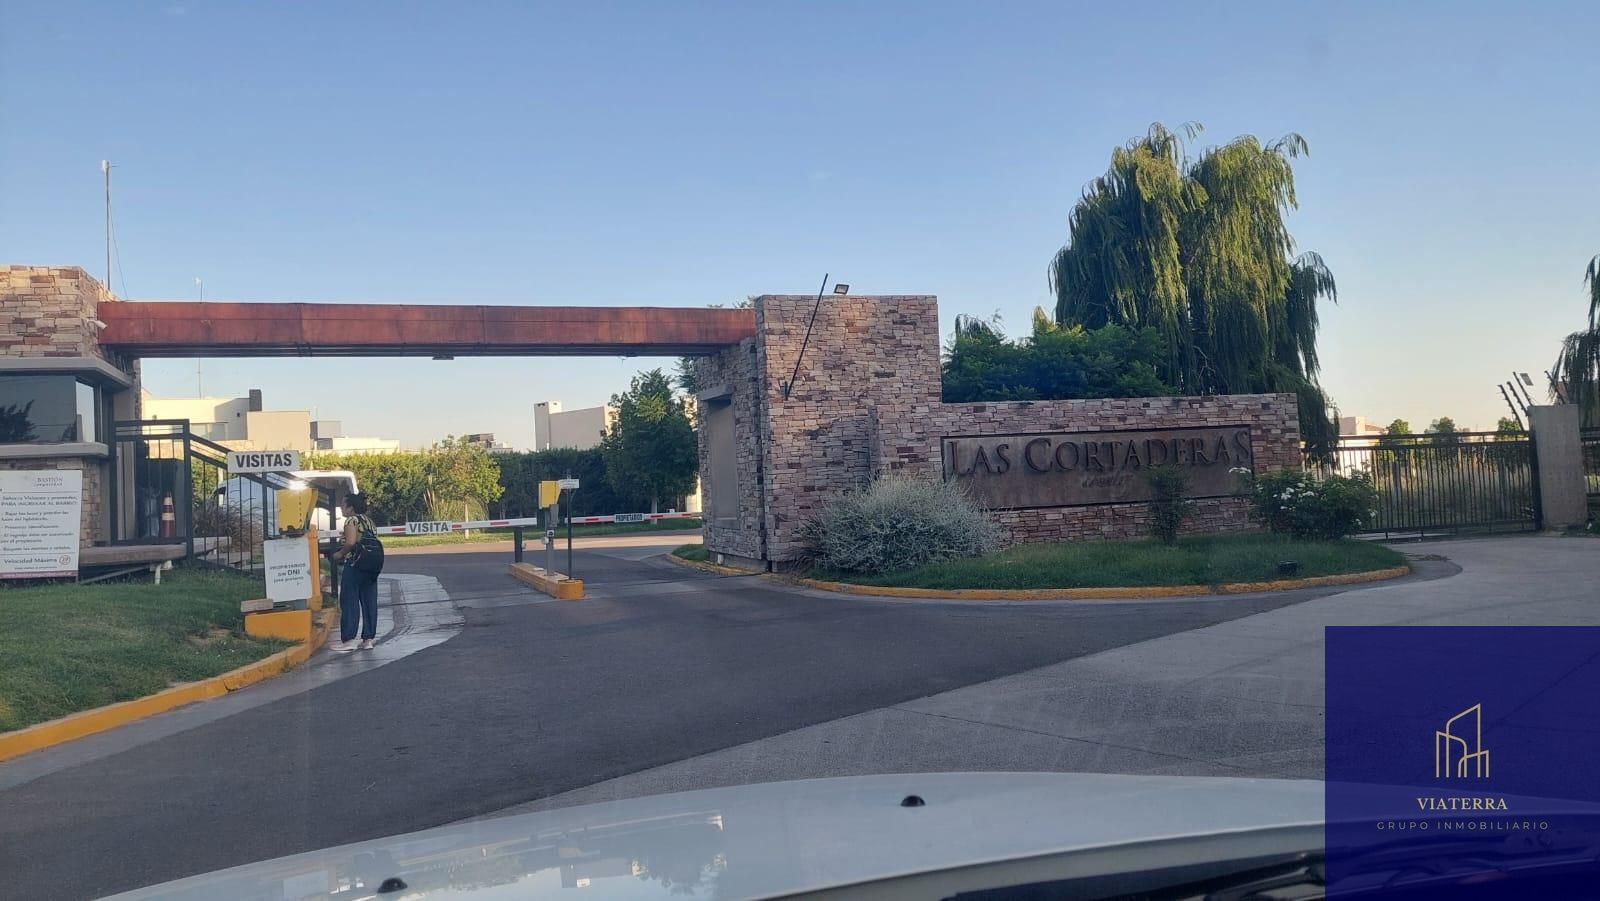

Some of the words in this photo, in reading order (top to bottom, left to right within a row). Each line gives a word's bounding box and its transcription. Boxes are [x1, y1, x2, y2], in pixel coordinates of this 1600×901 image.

[235, 453, 293, 468] VISITAS
[945, 440, 1010, 477] LAS
[1024, 430, 1250, 474] CORTADERAS
[409, 522, 449, 533] VISITA
